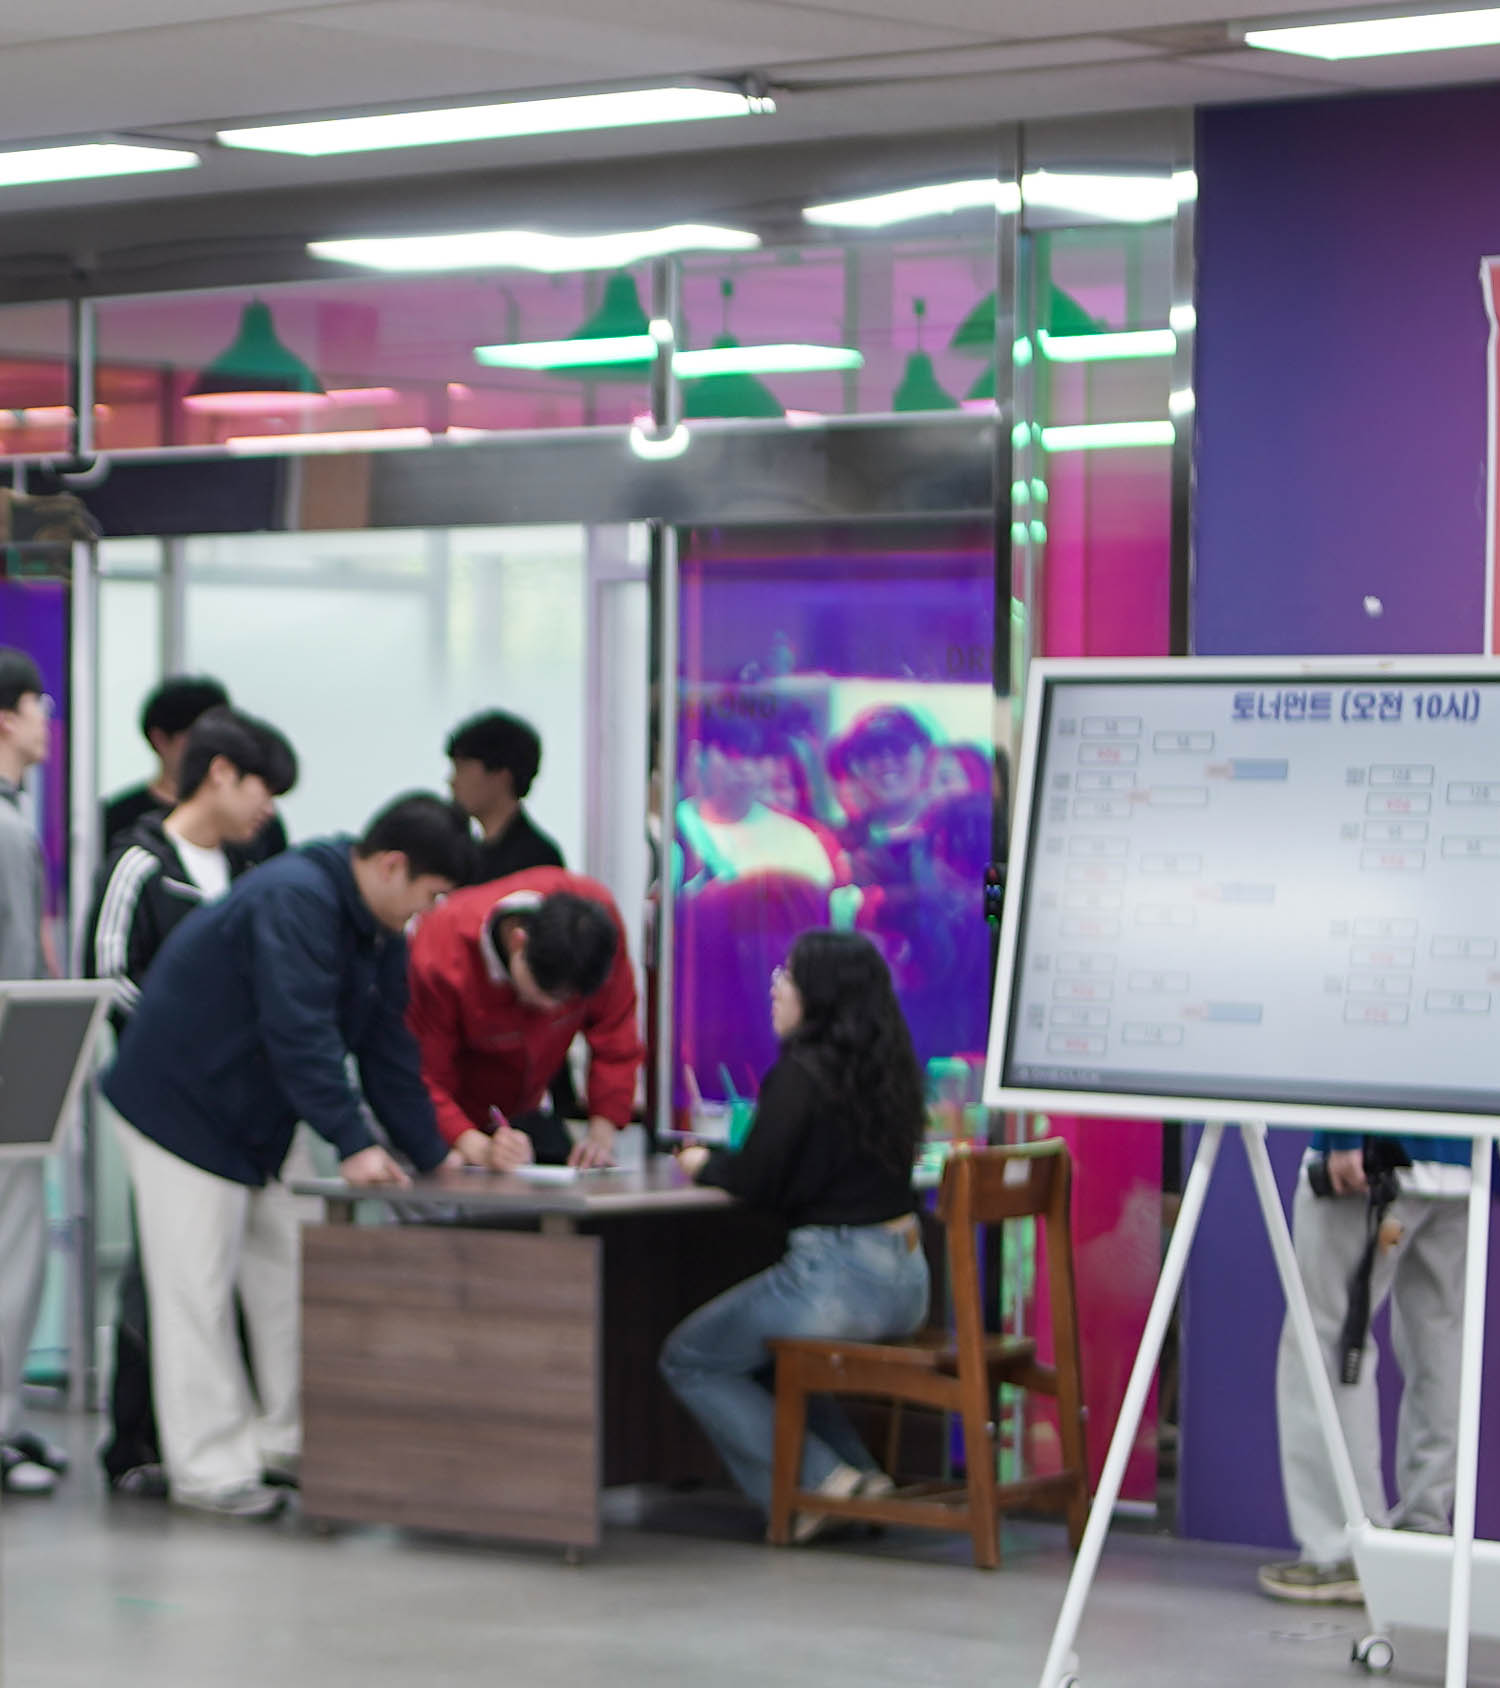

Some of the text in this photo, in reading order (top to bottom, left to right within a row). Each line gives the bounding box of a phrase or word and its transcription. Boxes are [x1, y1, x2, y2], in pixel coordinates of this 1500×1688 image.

[1231, 688, 1481, 723] 토너먼트 (오전 10시)
